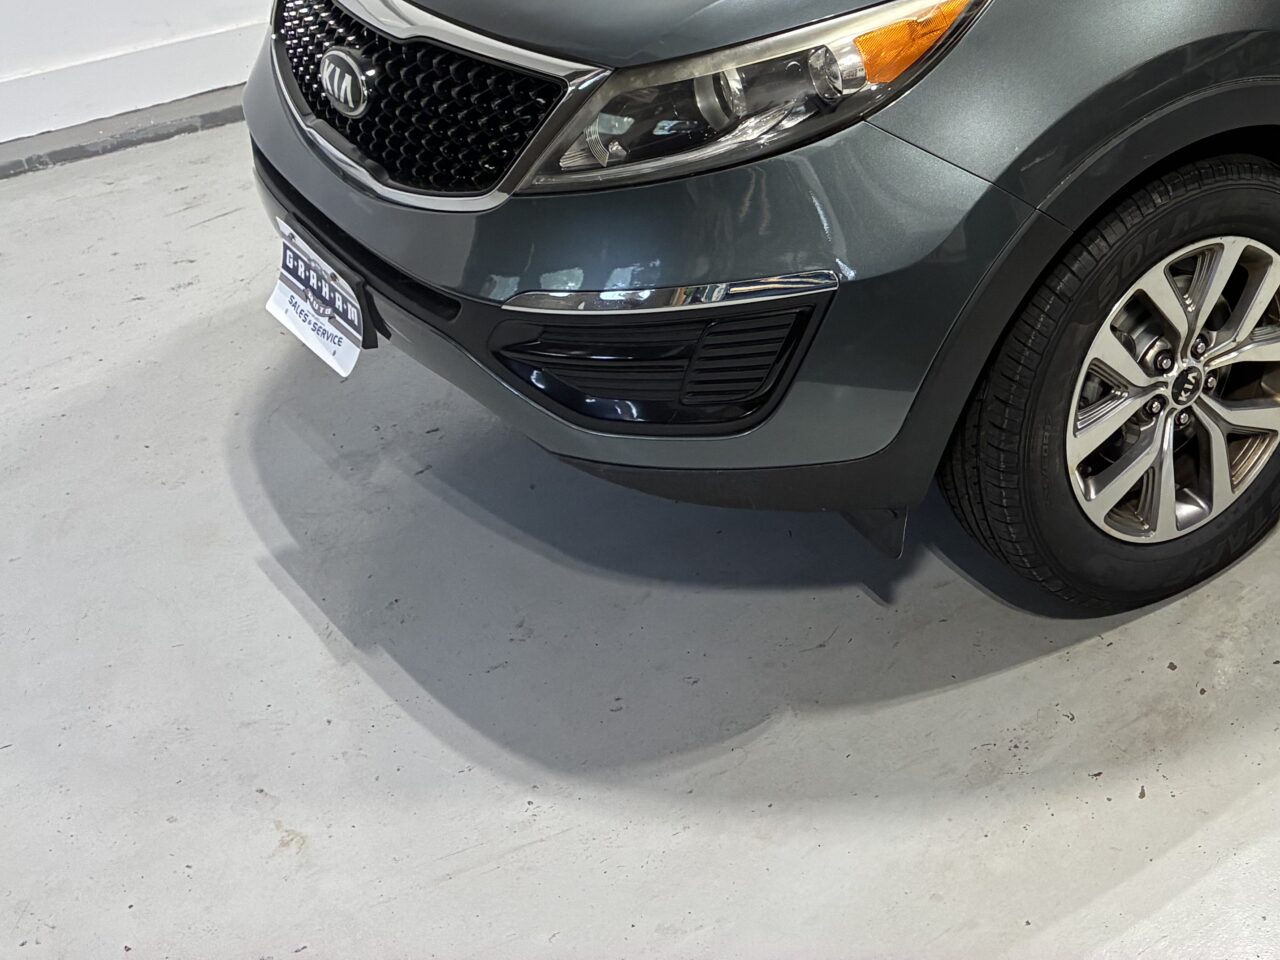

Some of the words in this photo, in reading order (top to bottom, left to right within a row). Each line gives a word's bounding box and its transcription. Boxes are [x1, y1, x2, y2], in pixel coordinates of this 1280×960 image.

[323, 58, 355, 109] KIA
[286, 249, 359, 327] GRAHAM
[288, 295, 308, 323] SALES
[311, 322, 343, 347] SERVICE
[1178, 372, 1198, 401] KIA
